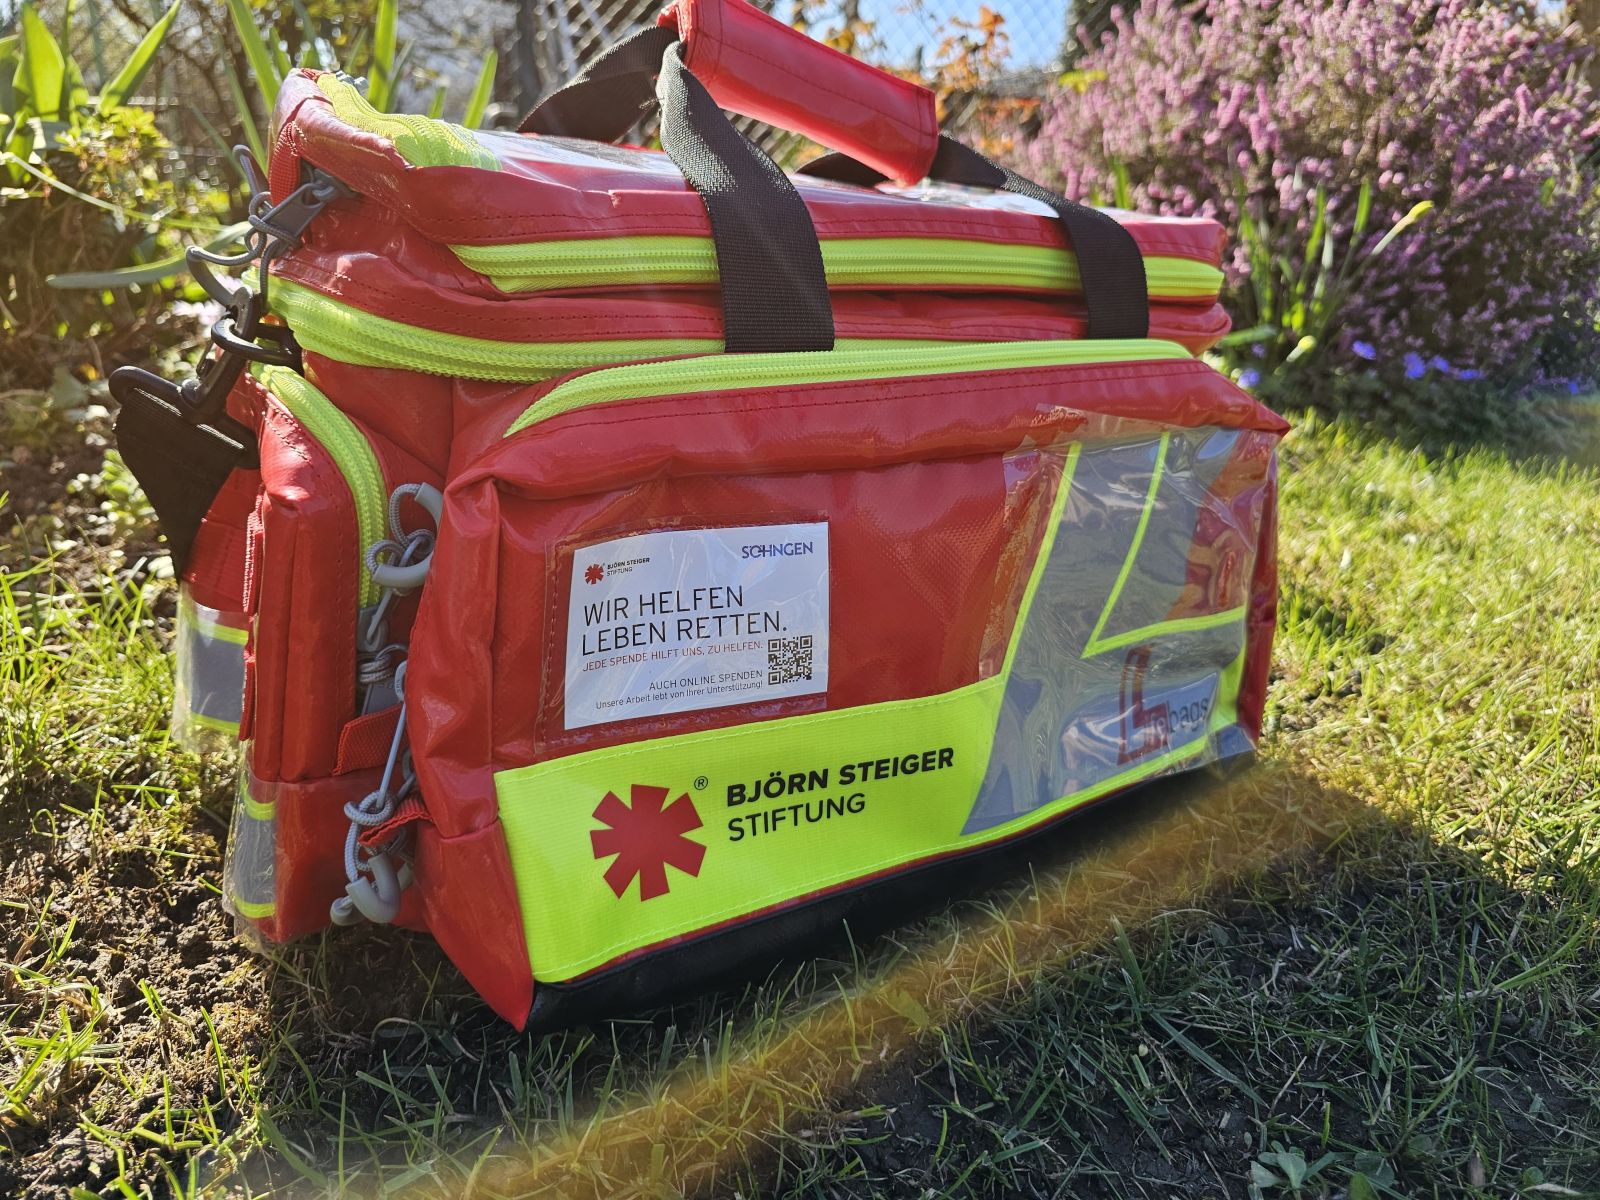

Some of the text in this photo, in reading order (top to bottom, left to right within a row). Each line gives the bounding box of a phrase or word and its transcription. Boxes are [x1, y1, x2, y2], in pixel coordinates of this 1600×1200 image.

[607, 557, 651, 570] BJÖRN STEIGER
[607, 567, 633, 576] STIFTUNG
[584, 585, 743, 627] WIR HELFEN
[582, 610, 787, 656] LEBEN RETTEN.
[582, 657, 607, 672] JEDE
[609, 652, 648, 666] SPENDE
[651, 648, 679, 661] HILFT
[707, 644, 721, 655] ZU
[723, 641, 763, 652] HELFEN.
[596, 679, 763, 710] Unsere Arbeit lebt von Ihrer Unterstützung!
[649, 670, 763, 691] AUCH ONLINE SPENDEN
[727, 747, 954, 807] BJÖRN STEIGER
[728, 793, 866, 841] STIFTUNG
